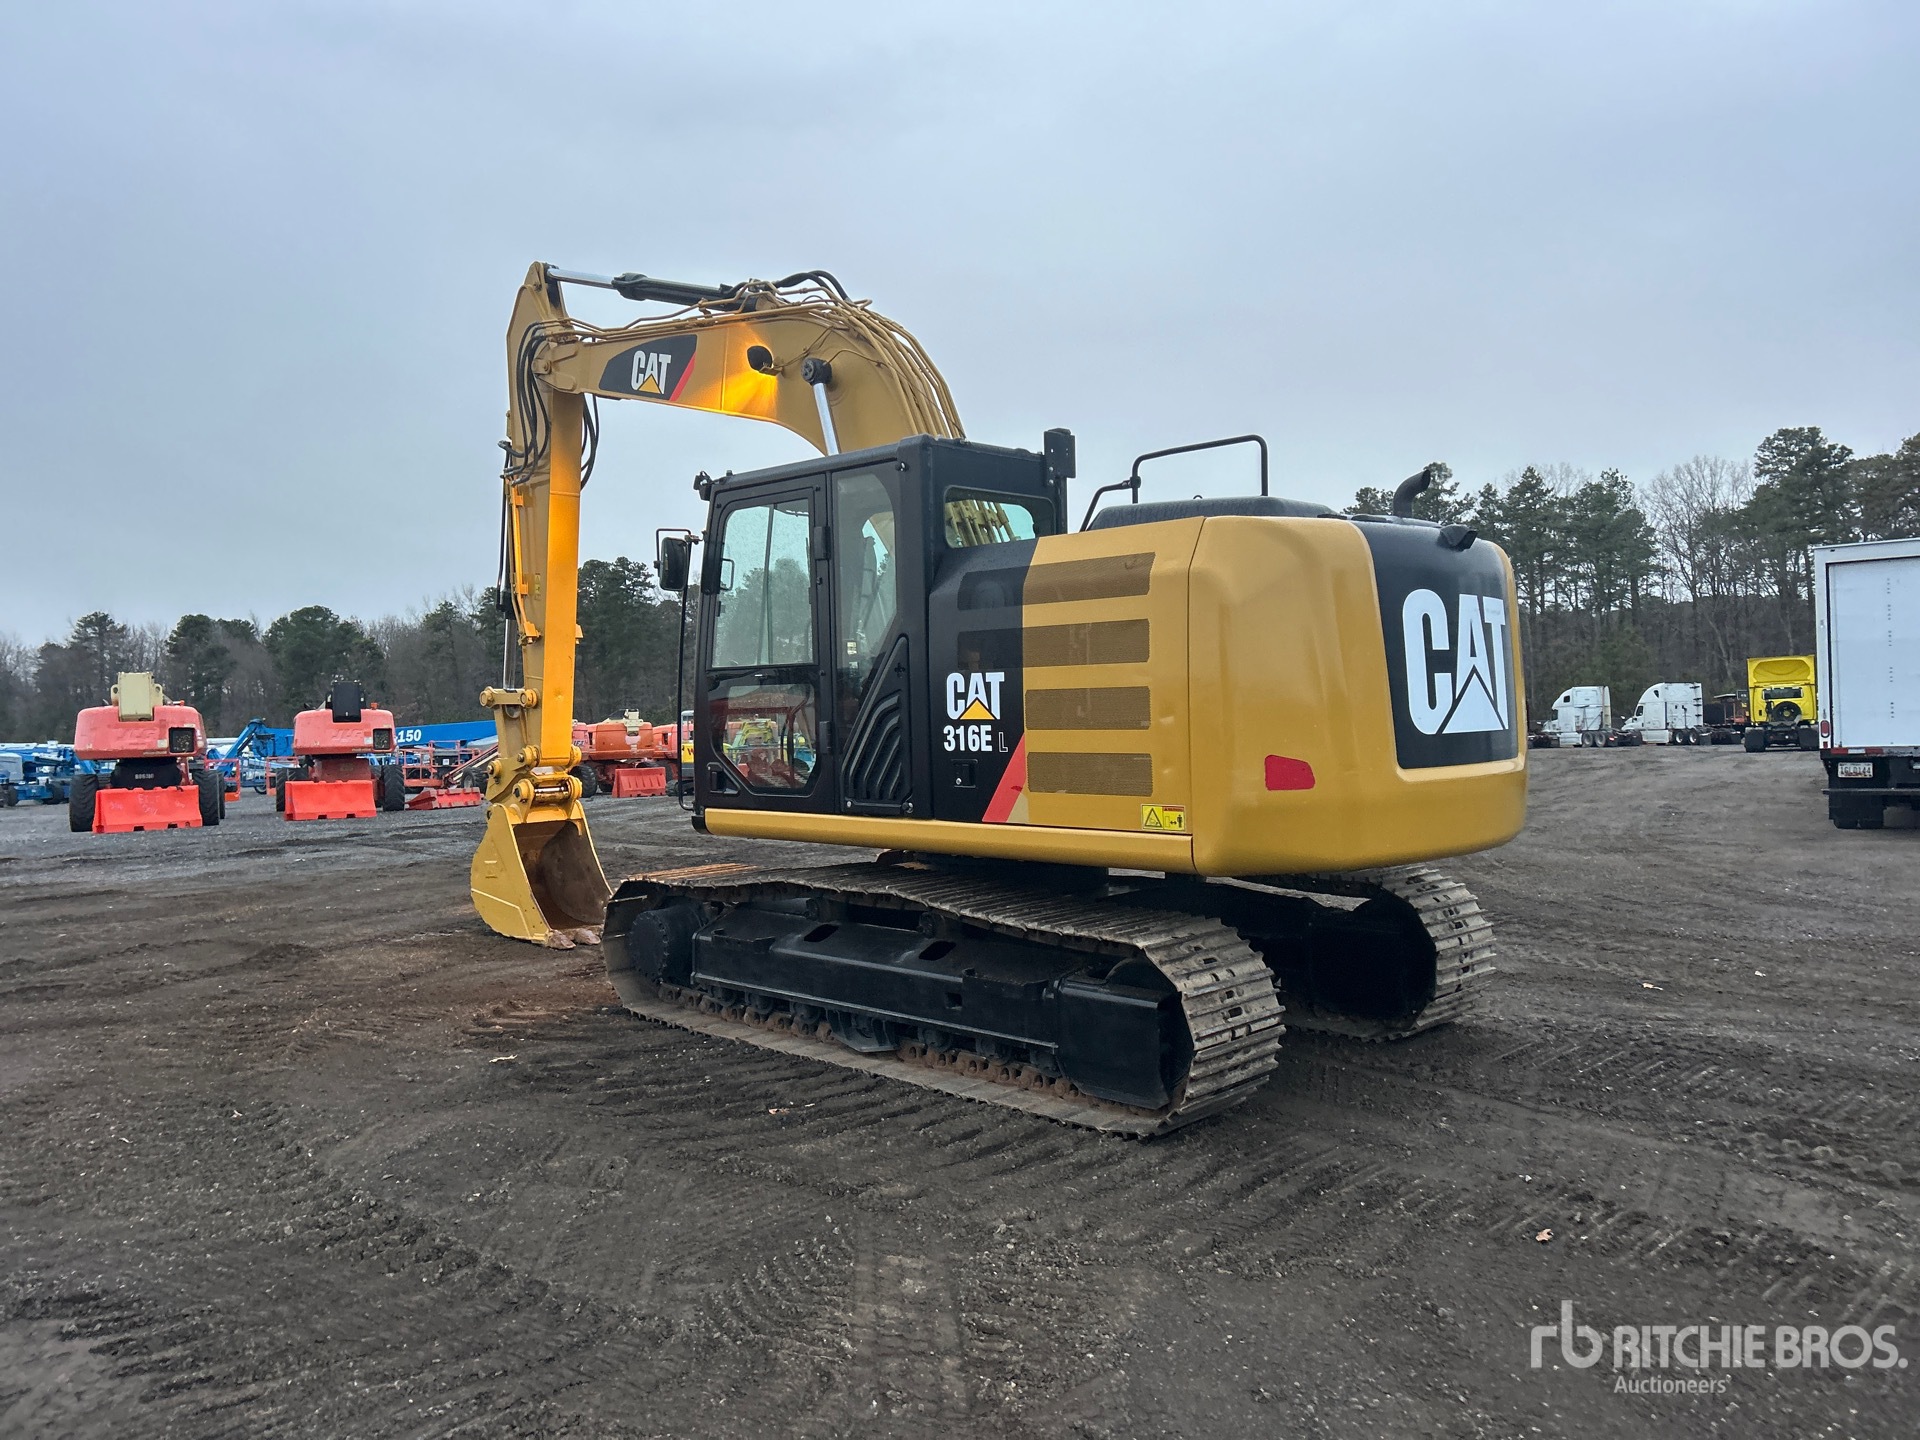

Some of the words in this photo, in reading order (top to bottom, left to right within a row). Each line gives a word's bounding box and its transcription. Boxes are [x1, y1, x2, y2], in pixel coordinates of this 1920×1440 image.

[631, 350, 672, 395] CAT
[1402, 588, 1509, 735] CAT
[946, 671, 1005, 720] CAT
[943, 725, 993, 752] 316E
[998, 731, 1009, 753] L
